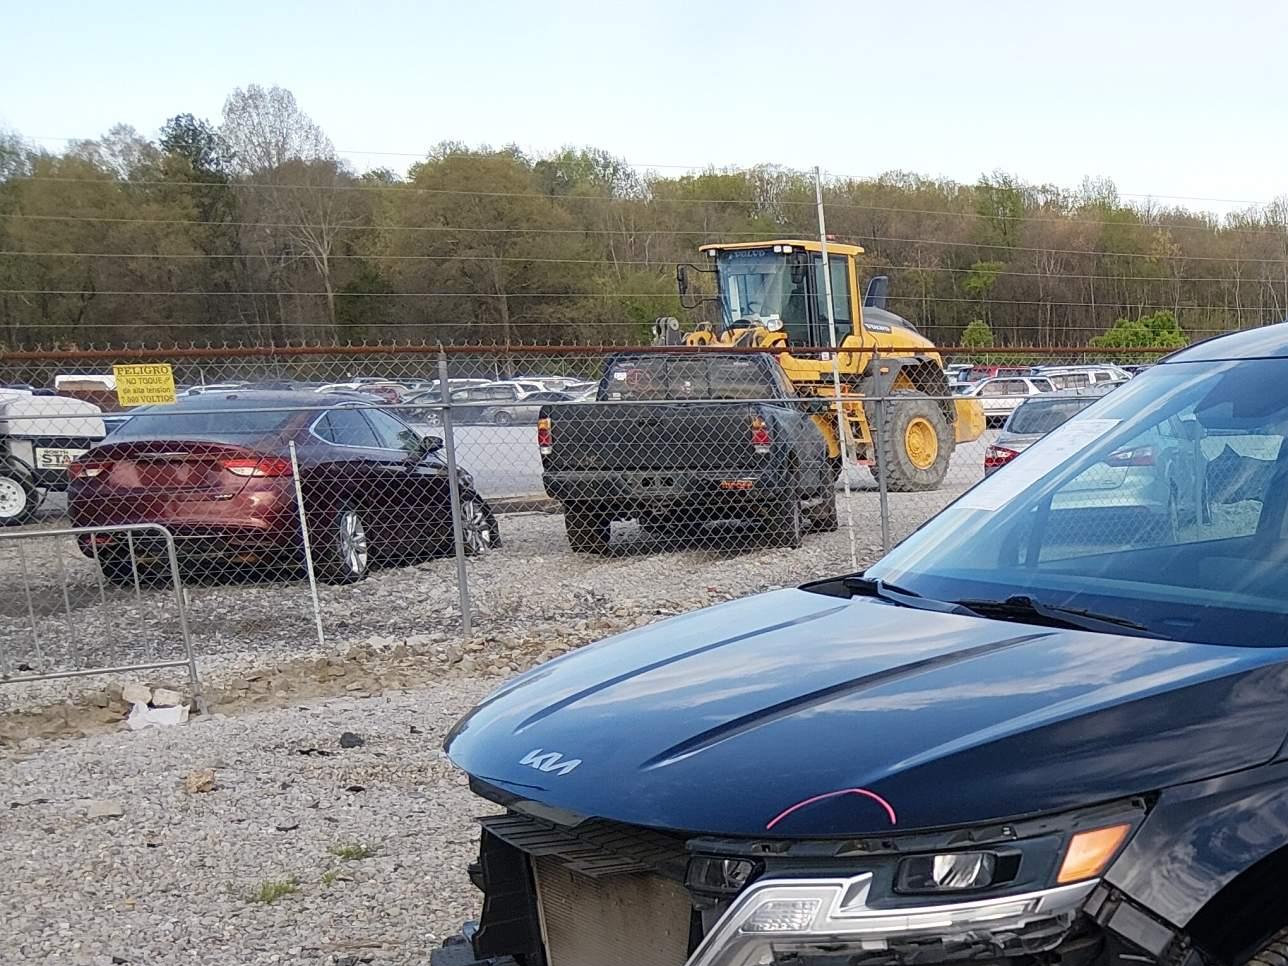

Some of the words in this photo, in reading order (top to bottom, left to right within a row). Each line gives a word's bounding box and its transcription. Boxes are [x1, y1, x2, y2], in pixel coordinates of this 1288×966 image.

[117, 366, 169, 375] PELIGRO
[126, 377, 136, 385] NO
[138, 377, 162, 385] TOQUE
[140, 395, 174, 403] VOLTIOS
